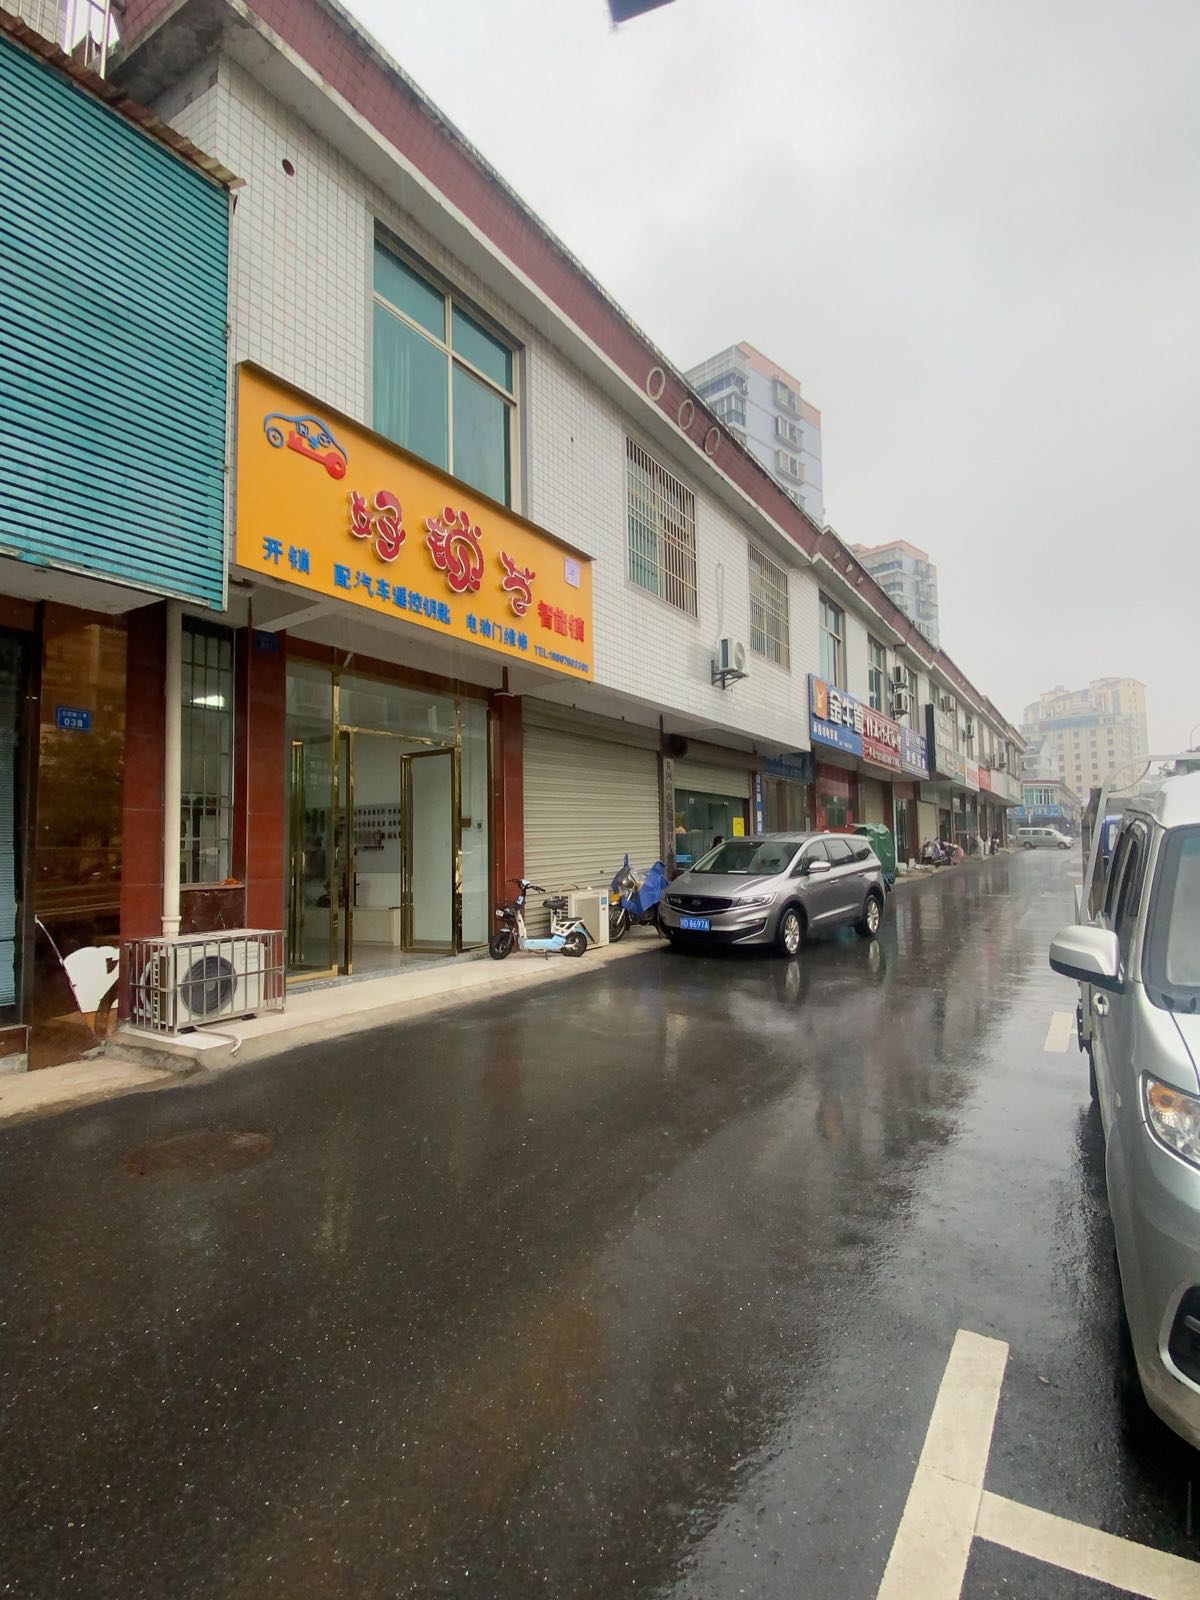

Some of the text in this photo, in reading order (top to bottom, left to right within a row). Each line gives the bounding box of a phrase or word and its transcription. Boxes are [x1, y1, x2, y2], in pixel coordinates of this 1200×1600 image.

[262, 535, 528, 651] 开锁 配汽车遥控钥匙 电动门维修
[537, 600, 584, 643] 智能锁
[64, 717, 83, 727] 038
